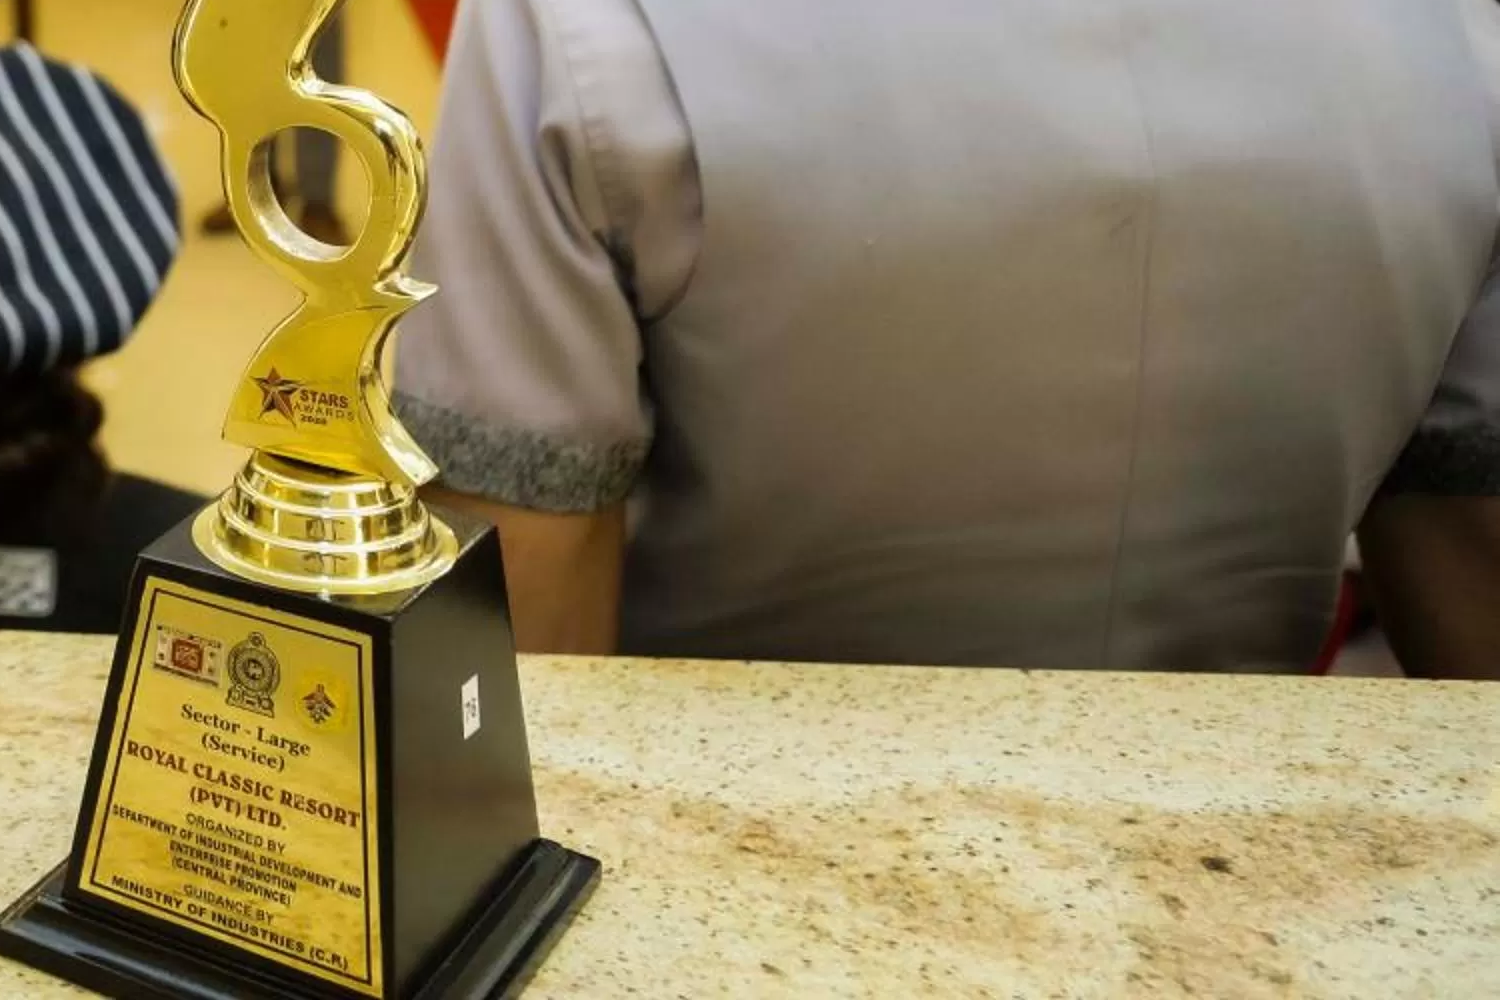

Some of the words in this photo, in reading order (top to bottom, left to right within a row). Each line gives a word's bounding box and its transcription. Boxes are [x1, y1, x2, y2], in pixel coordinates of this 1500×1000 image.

[294, 401, 355, 421] AWARDS
[300, 389, 349, 409] STARS
[181, 703, 241, 735] Sector
[257, 726, 311, 757] Large
[201, 731, 285, 772] (Service)
[126, 739, 188, 773] ROYAL
[193, 763, 274, 801] CLASSIC
[280, 789, 360, 828] RESORT
[189, 785, 241, 818] (PVT)
[247, 803, 287, 831] LTD.
[112, 804, 177, 837] DEPARTMENT
[179, 828, 193, 841] OF
[196, 834, 256, 865] INDUSTRIAL
[259, 854, 336, 890] DEVELOPMENT
[339, 881, 362, 899] AND
[186, 813, 263, 849] ORGANIZED
[268, 840, 286, 855] BY
[169, 839, 232, 872] ENTERPRISE
[235, 859, 297, 893] PROMOTION
[171, 856, 227, 885] (CENTRAL
[230, 876, 291, 906] PROVINCE)
[112, 875, 182, 909] MINISTRY
[187, 902, 206, 918] OF
[211, 913, 305, 954] INDUSTRIES
[183, 884, 252, 917] GUIDANCE
[256, 910, 275, 925] BY
